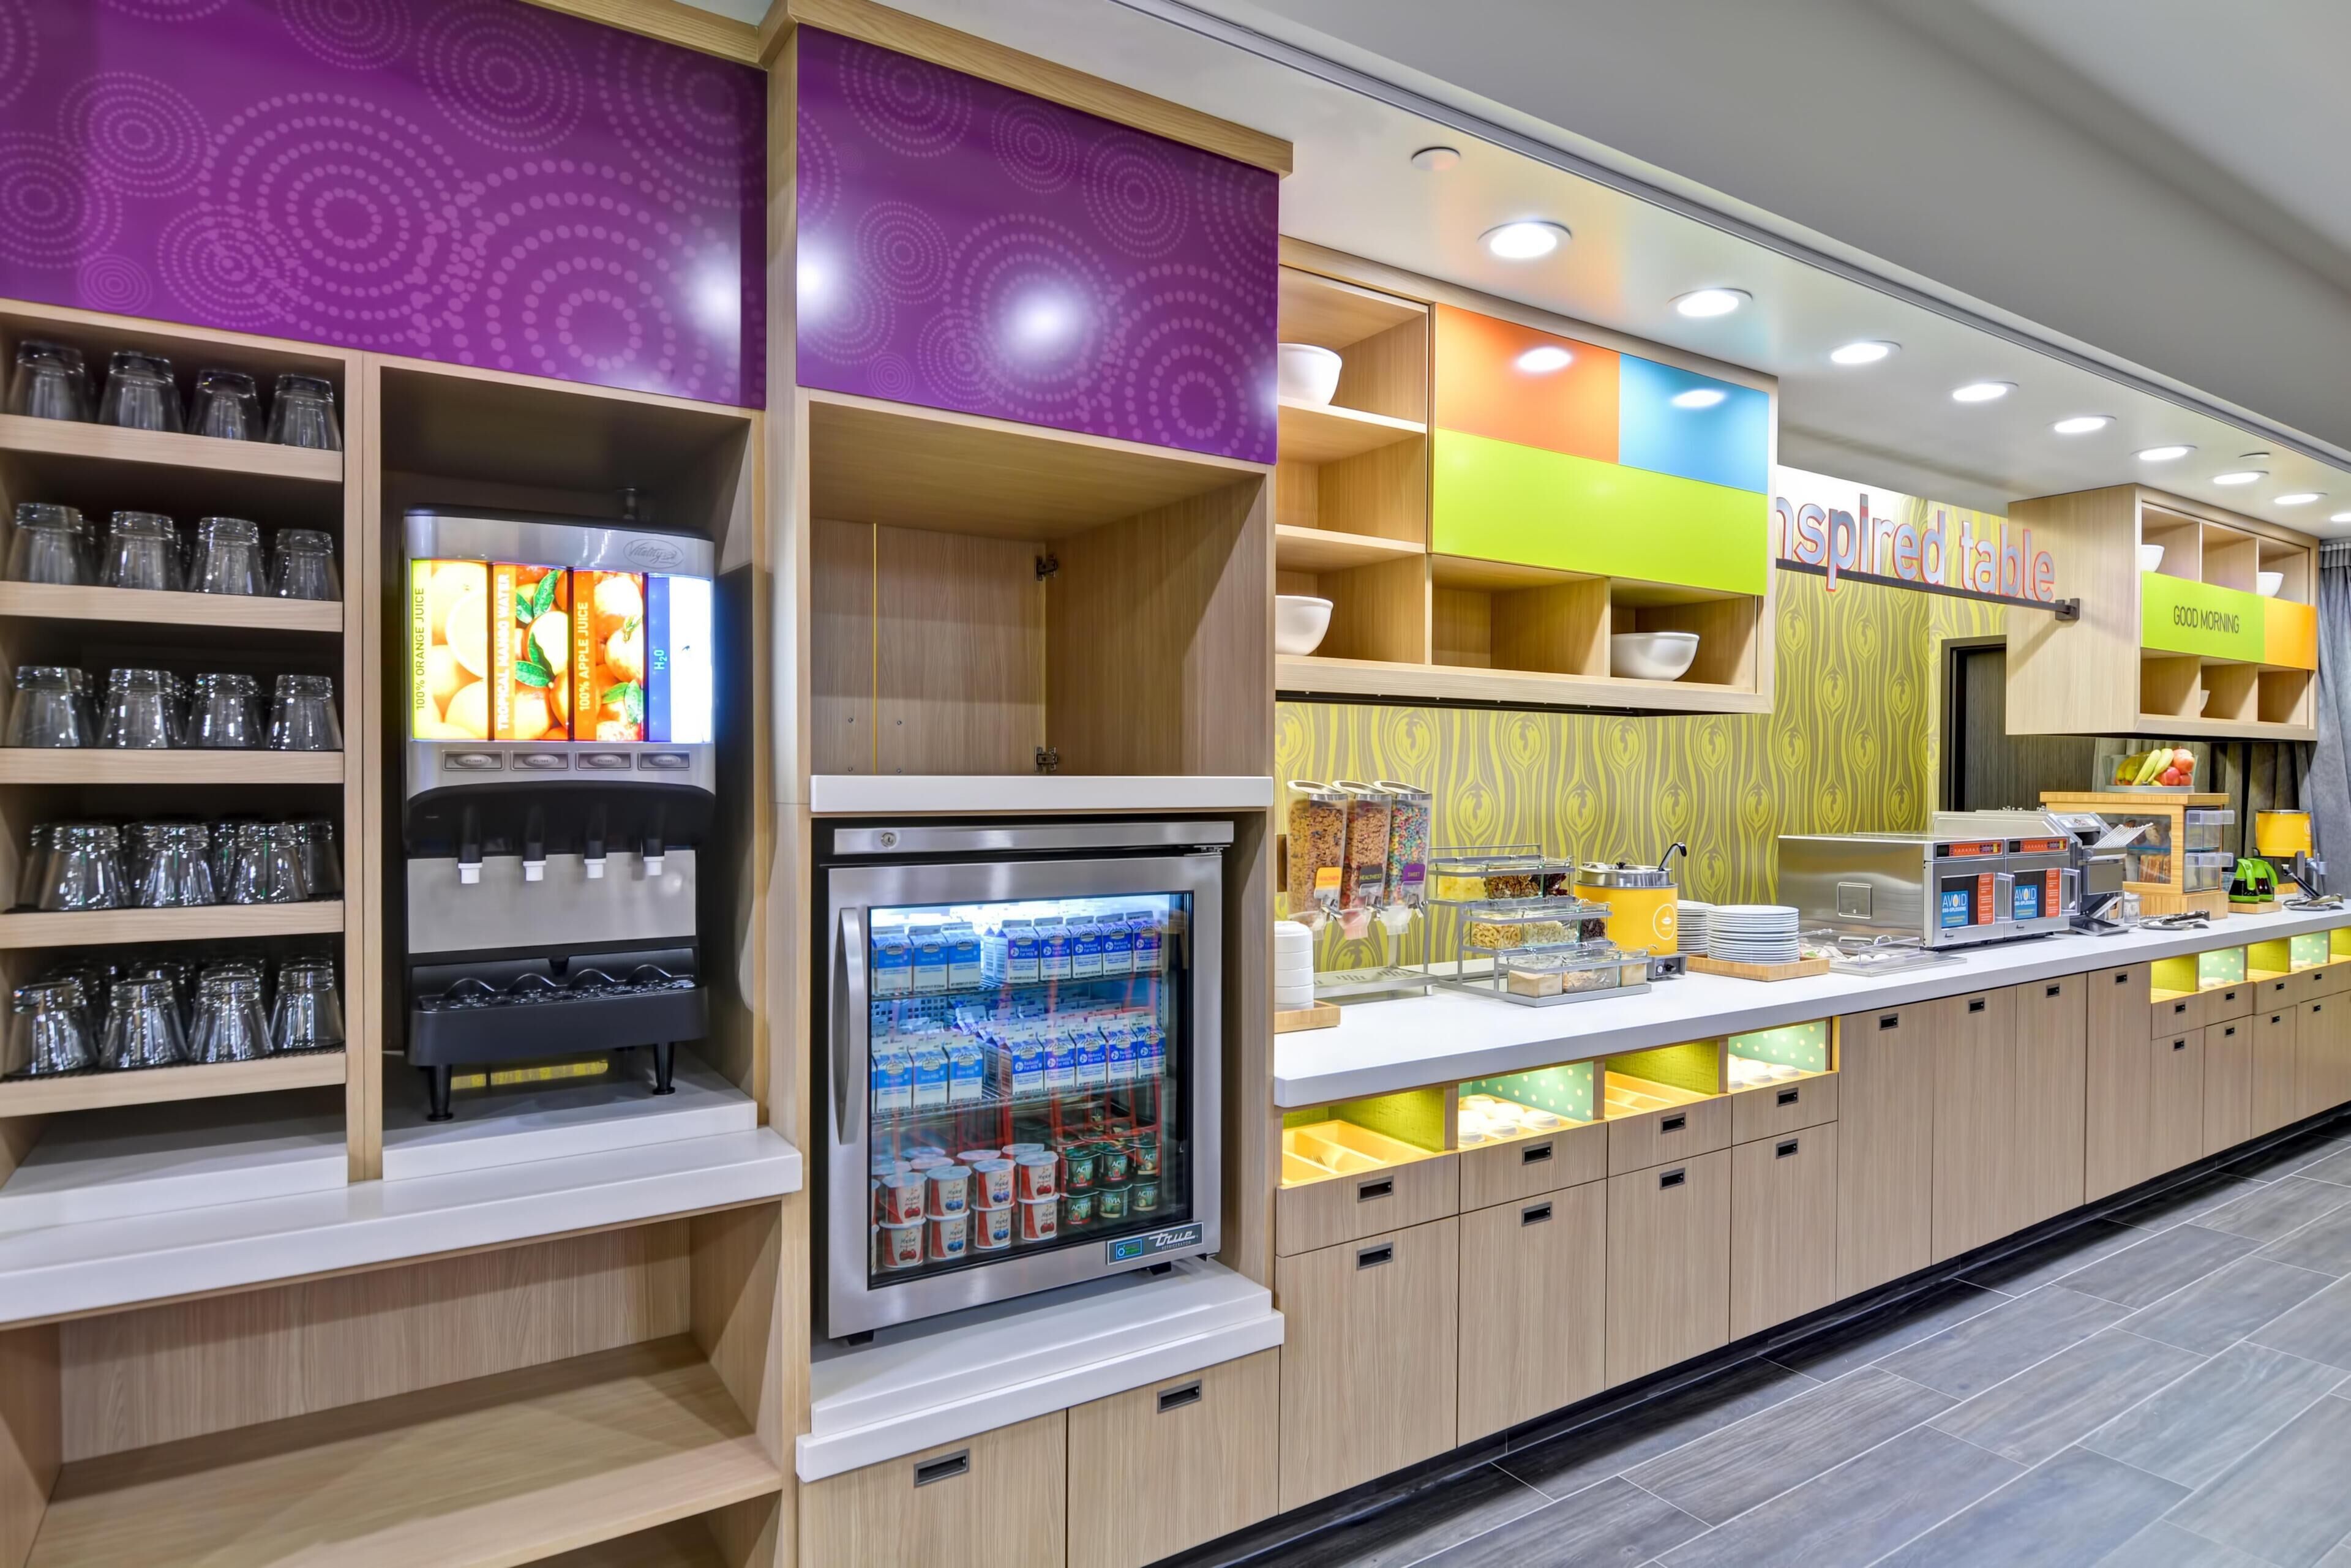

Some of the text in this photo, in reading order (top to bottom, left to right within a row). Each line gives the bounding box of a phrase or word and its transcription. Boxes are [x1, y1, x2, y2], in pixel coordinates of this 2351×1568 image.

[1960, 520, 2055, 603] table
[497, 574, 510, 618] WATER
[2173, 605, 2240, 634] GOOD MORNING
[415, 588, 425, 710] 100% ORANGE JUICE
[577, 602, 590, 711] 100% APPLE JUICE
[497, 669, 509, 731] TROPICAL
[1942, 893, 1967, 908] AVOID
[2014, 887, 2036, 901] AVOID
